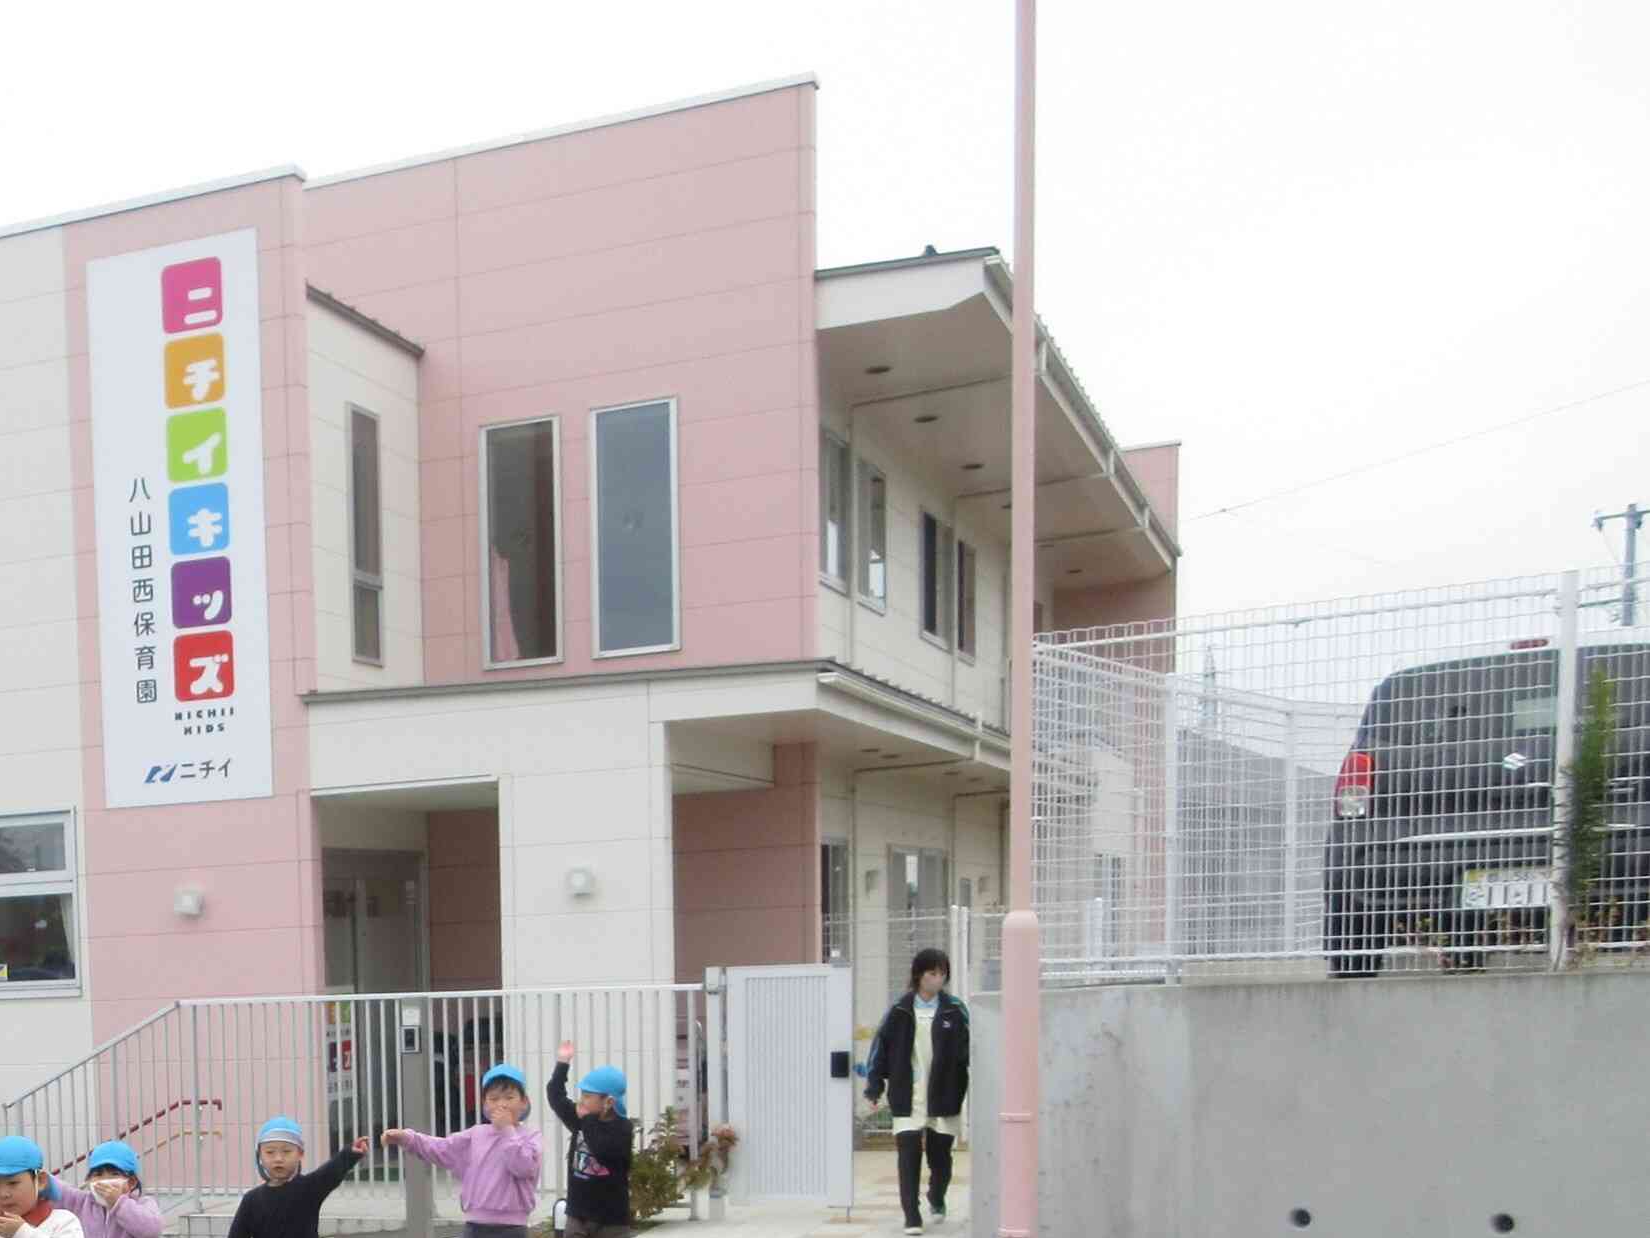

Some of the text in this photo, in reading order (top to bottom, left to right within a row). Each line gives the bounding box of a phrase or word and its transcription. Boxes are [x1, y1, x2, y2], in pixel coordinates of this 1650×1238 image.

[181, 284, 231, 696] ニチイキッズ
[129, 476, 158, 704] 八山田西保育園
[174, 706, 234, 721] NICHII
[183, 722, 225, 736] KIDS
[180, 758, 232, 779] ニチイ
